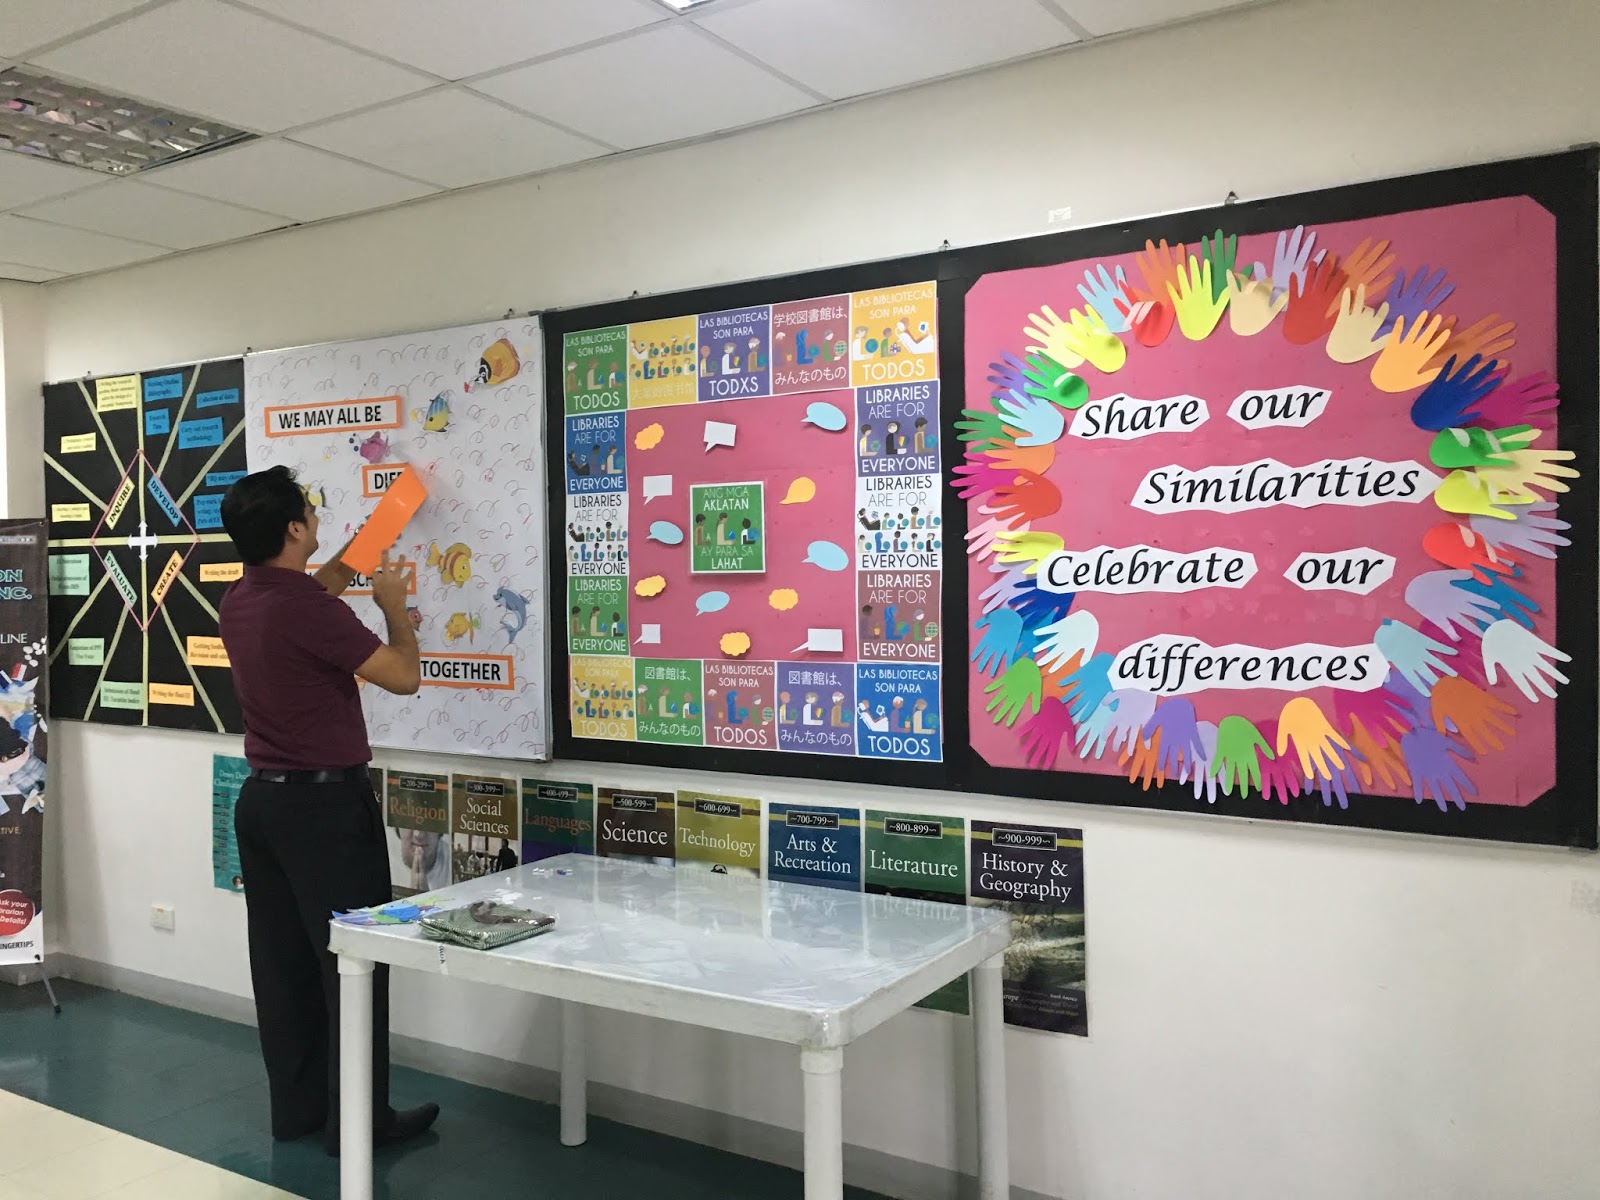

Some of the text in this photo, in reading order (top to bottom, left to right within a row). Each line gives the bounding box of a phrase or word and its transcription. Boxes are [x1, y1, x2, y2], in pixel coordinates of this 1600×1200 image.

[854, 288, 933, 308] LAS BIBLIOTECAS
[700, 311, 768, 329] LAS BIBLIOTECAS
[869, 305, 917, 320] SON PARA
[580, 330, 625, 345] BIBLIOTECAS
[713, 325, 753, 340] SON PARA
[577, 344, 613, 357] SON PARA
[774, 366, 846, 385] みんなのもの
[862, 359, 925, 381] TODOS
[709, 376, 758, 396] TODXS
[865, 385, 930, 404] LIBRARIES
[573, 391, 620, 410] TODOS
[278, 405, 382, 429] WE MAY ALL BE
[868, 402, 925, 419] ARE FOR
[1081, 390, 1323, 437] Share our
[572, 415, 619, 431] LIBRARIES
[574, 430, 616, 444] ARE FOR
[862, 455, 935, 473] EVERYONE
[374, 472, 403, 489] DIF
[570, 476, 623, 491] EVERYONE
[866, 475, 932, 491] LIBRARIES
[1144, 460, 1420, 505] Similarities
[108, 483, 131, 523] INQUIRE
[150, 480, 179, 520] DEVELOP
[574, 494, 621, 508] LIBRARIES
[703, 498, 749, 511] AKLATAN
[868, 491, 927, 507] ARE FOR
[575, 508, 617, 522] ARE FOR
[716, 546, 738, 556] PARA
[742, 546, 754, 556] SA
[572, 562, 626, 574] EVERYONE
[711, 557, 743, 569] LAHAT
[862, 554, 938, 568] EVERYONE
[1047, 548, 1384, 587] Celebrate our
[106, 555, 135, 603] EVALUATE
[156, 559, 179, 596] CREATE
[575, 579, 621, 591] LIBRARIES
[867, 574, 932, 588] LIBRARIES
[577, 593, 618, 605] ARE FOR
[869, 589, 927, 604] ARE FOR
[572, 638, 626, 651] EVERYONE
[863, 642, 936, 658] EVERYONE
[421, 660, 500, 681] TOGETHER
[705, 664, 774, 676] LAS BIBLIOTECAS
[858, 669, 938, 680] LAS BIBLIOTECAS
[1117, 643, 1370, 692] differences
[718, 677, 759, 688] SON PARA
[875, 682, 921, 694] SON PARA
[580, 720, 628, 738] TODOS
[639, 721, 700, 737] みんなのもの
[714, 726, 768, 745] TODOS
[780, 729, 852, 746] みんなのもの
[867, 735, 931, 756] TODOS
[389, 797, 446, 825] Religion
[466, 797, 502, 816] Social
[460, 814, 509, 834] Sciences
[525, 808, 591, 835] Languages
[602, 818, 668, 845] Science
[679, 827, 756, 857] Technology
[786, 833, 838, 854] Arts &
[774, 851, 851, 874] Recreation
[870, 849, 958, 878] Literature
[982, 852, 1069, 879] History &
[979, 873, 1072, 903] Geography
